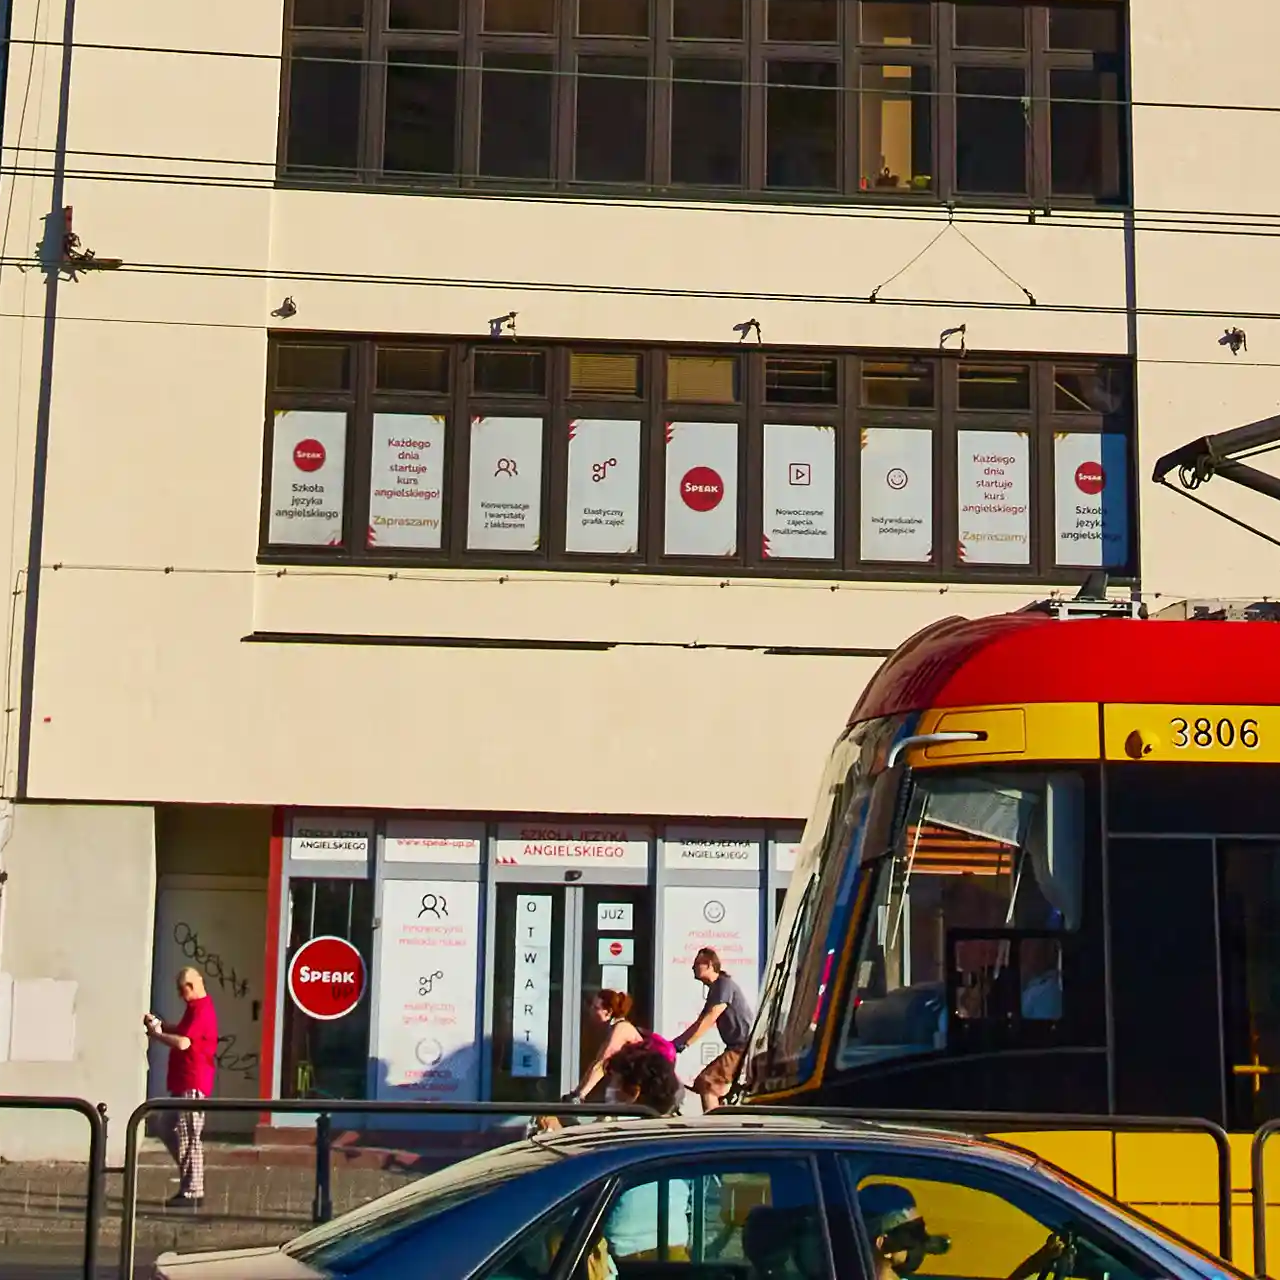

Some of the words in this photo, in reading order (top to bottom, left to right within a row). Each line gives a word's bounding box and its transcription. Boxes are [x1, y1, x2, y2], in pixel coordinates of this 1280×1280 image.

[388, 437, 431, 449] Każdego
[398, 451, 419, 460] dnia
[973, 453, 1016, 465] Każdego
[389, 464, 427, 474] startuje
[984, 466, 1005, 476] dnia
[397, 476, 418, 486] kurs
[976, 479, 1013, 489] startuje
[291, 483, 324, 493] Szkoła
[374, 488, 440, 501] angielskiego!
[984, 492, 1005, 501] kurs
[291, 495, 323, 507] języka
[275, 508, 339, 520] angielskiego
[583, 507, 624, 518] Elastyczny
[775, 508, 824, 516] Nowoczesne
[373, 515, 440, 530] Zapraszamy
[581, 517, 603, 527] grafik
[772, 527, 828, 536] multimedialne
[962, 530, 1028, 544] Zapraszamy
[1170, 717, 1260, 749] 3806
[299, 840, 367, 851] ANGIELSKIEGO
[523, 844, 625, 858] ANGIELSKIEGO
[681, 850, 749, 860] ANGIELSKIEGO
[600, 907, 625, 921] JUŻ
